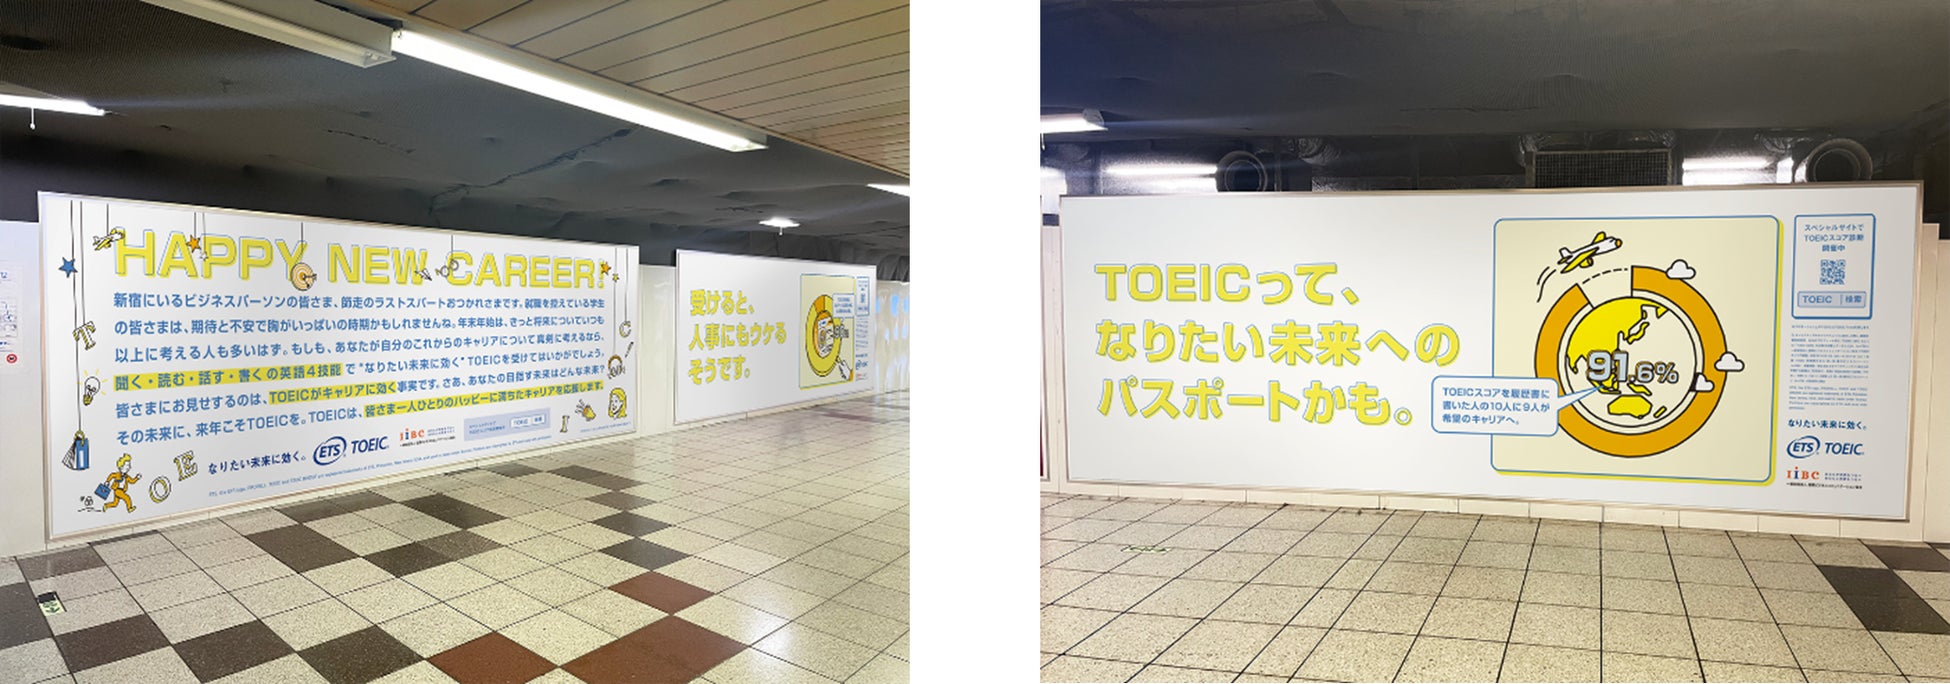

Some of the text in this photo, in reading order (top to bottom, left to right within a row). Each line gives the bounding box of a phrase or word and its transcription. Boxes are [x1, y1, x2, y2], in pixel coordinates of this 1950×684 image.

[113, 226, 607, 289] HAPPY NEW CAREER!
[1094, 263, 1360, 305] TOEICって、
[689, 288, 755, 316] 受けると、
[1802, 295, 1832, 303] TOEIC
[688, 321, 787, 350] 人事にもウケる
[1096, 318, 1460, 367] なりたい未来への
[687, 355, 751, 386] そうです。
[1586, 350, 1680, 384] 91.6%
[1097, 375, 1413, 426] パスポートかも。
[1442, 387, 1550, 399] TOEICスコアを履歴書に
[1442, 401, 1550, 412] 書いた人の10人に9人が
[1442, 414, 1519, 425] 希望のキャリアへ。
[1788, 419, 1867, 430] なりたい未来に効く。
[319, 443, 341, 458] ETS
[351, 436, 388, 454] TOEIC
[1793, 442, 1814, 453] ETS
[1825, 442, 1864, 455] TOEIC
[208, 451, 306, 475] なりたい未来に効く。
